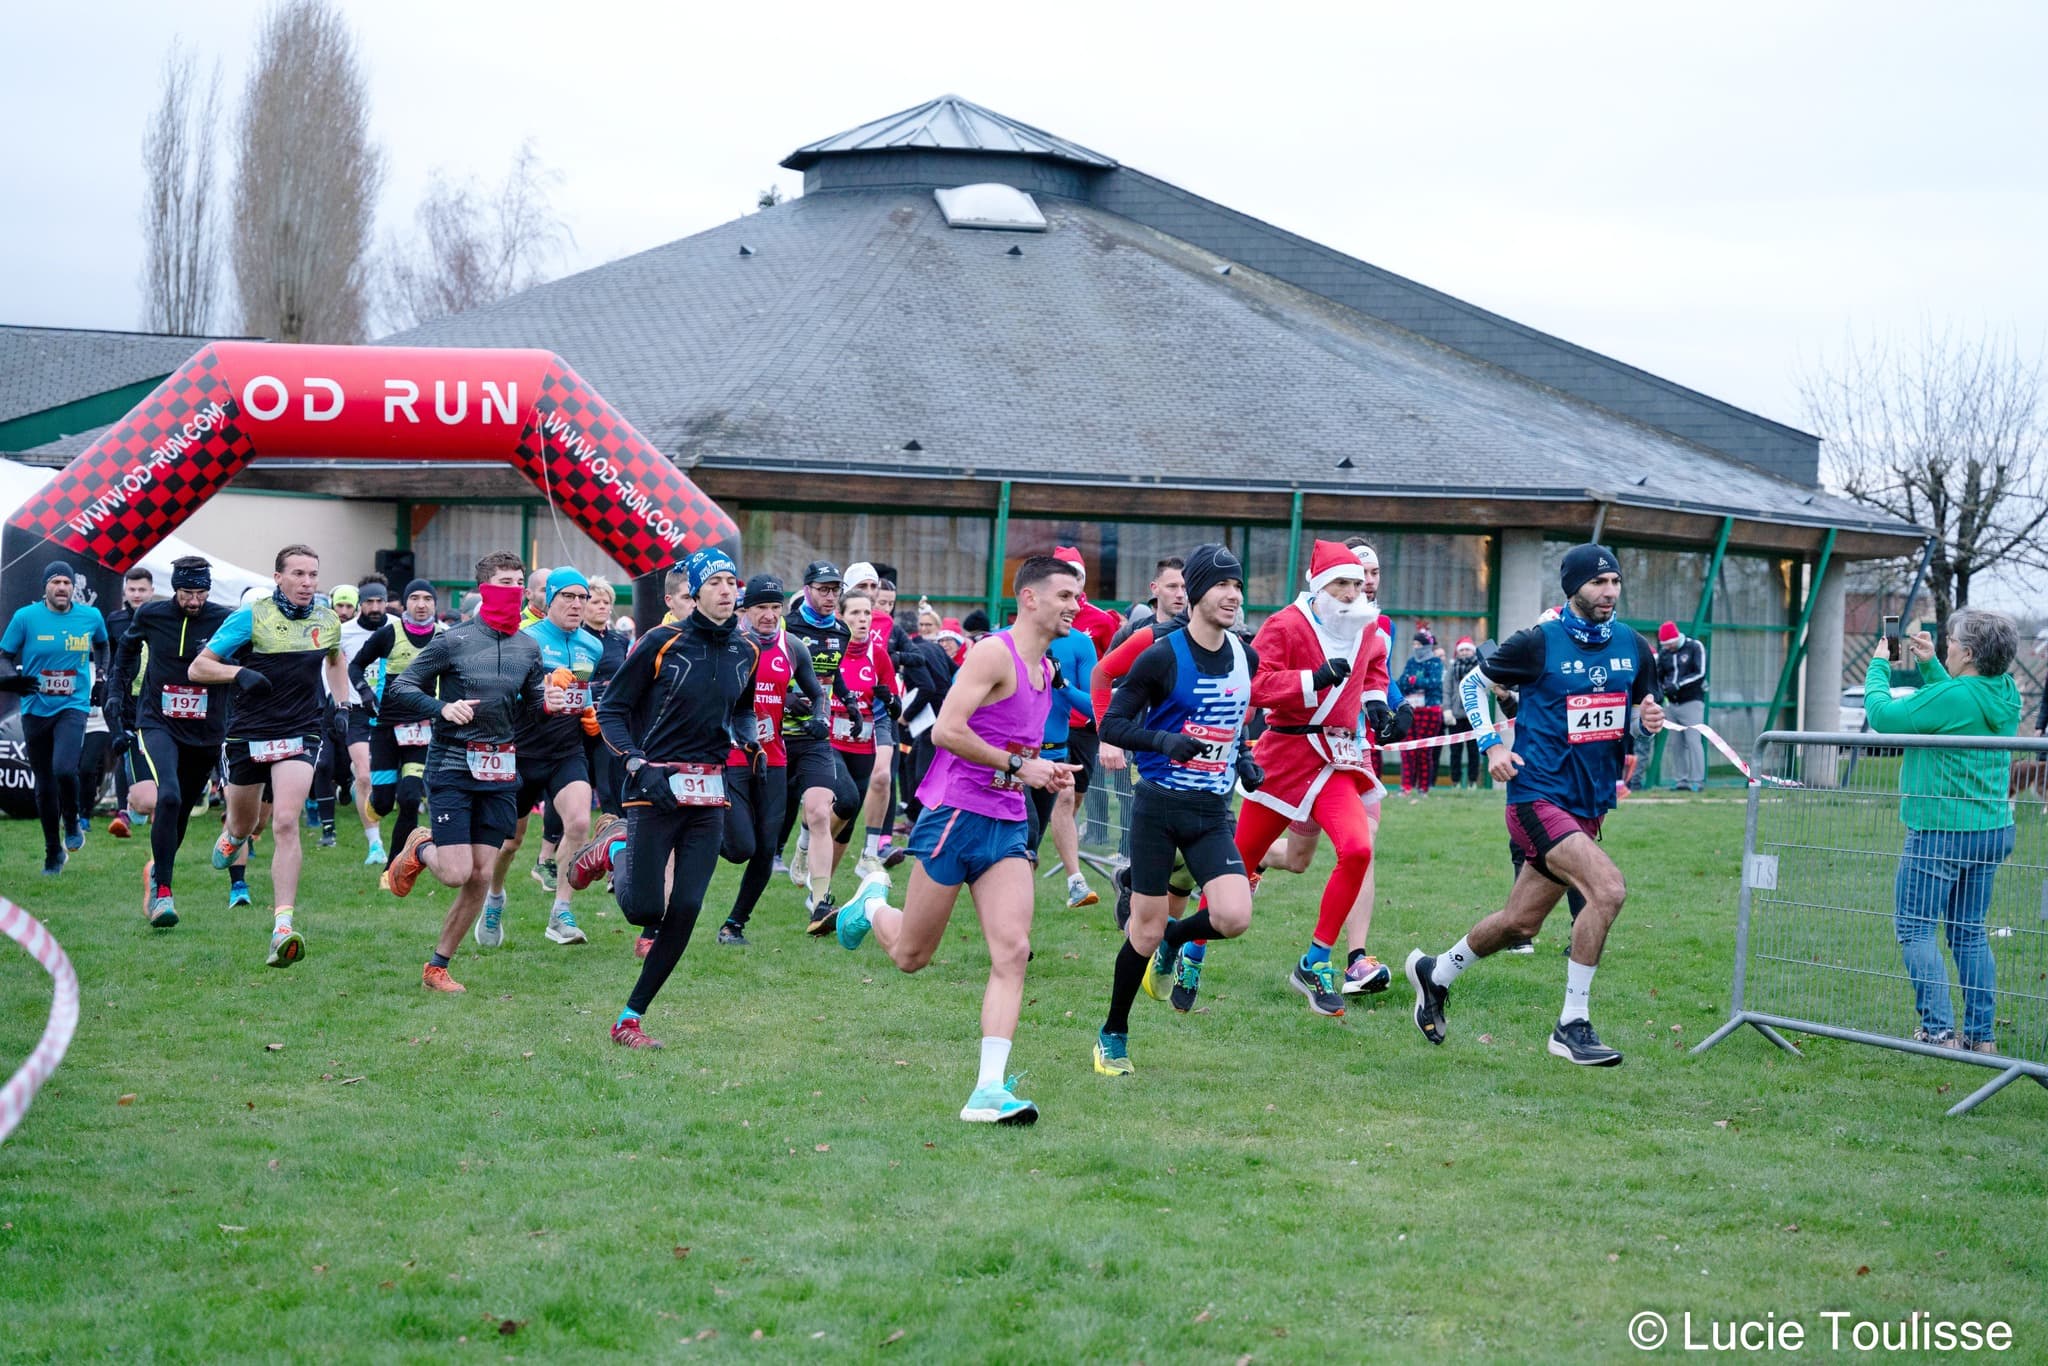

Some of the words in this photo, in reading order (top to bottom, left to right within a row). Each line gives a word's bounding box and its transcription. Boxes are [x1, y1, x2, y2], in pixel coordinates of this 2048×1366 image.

[242, 375, 345, 421] OD
[384, 379, 517, 425] RUN
[69, 400, 226, 536] WWW.OD-RUN.COM
[544, 410, 687, 548] WWW.OD-RUN.COM
[45, 679, 70, 689] 160
[171, 697, 200, 709] 197
[1576, 710, 1614, 729] 415
[758, 723, 768, 736] 2
[266, 739, 288, 751] 14
[1201, 743, 1224, 761] 21
[481, 756, 501, 770] 70
[684, 778, 706, 793] 91
